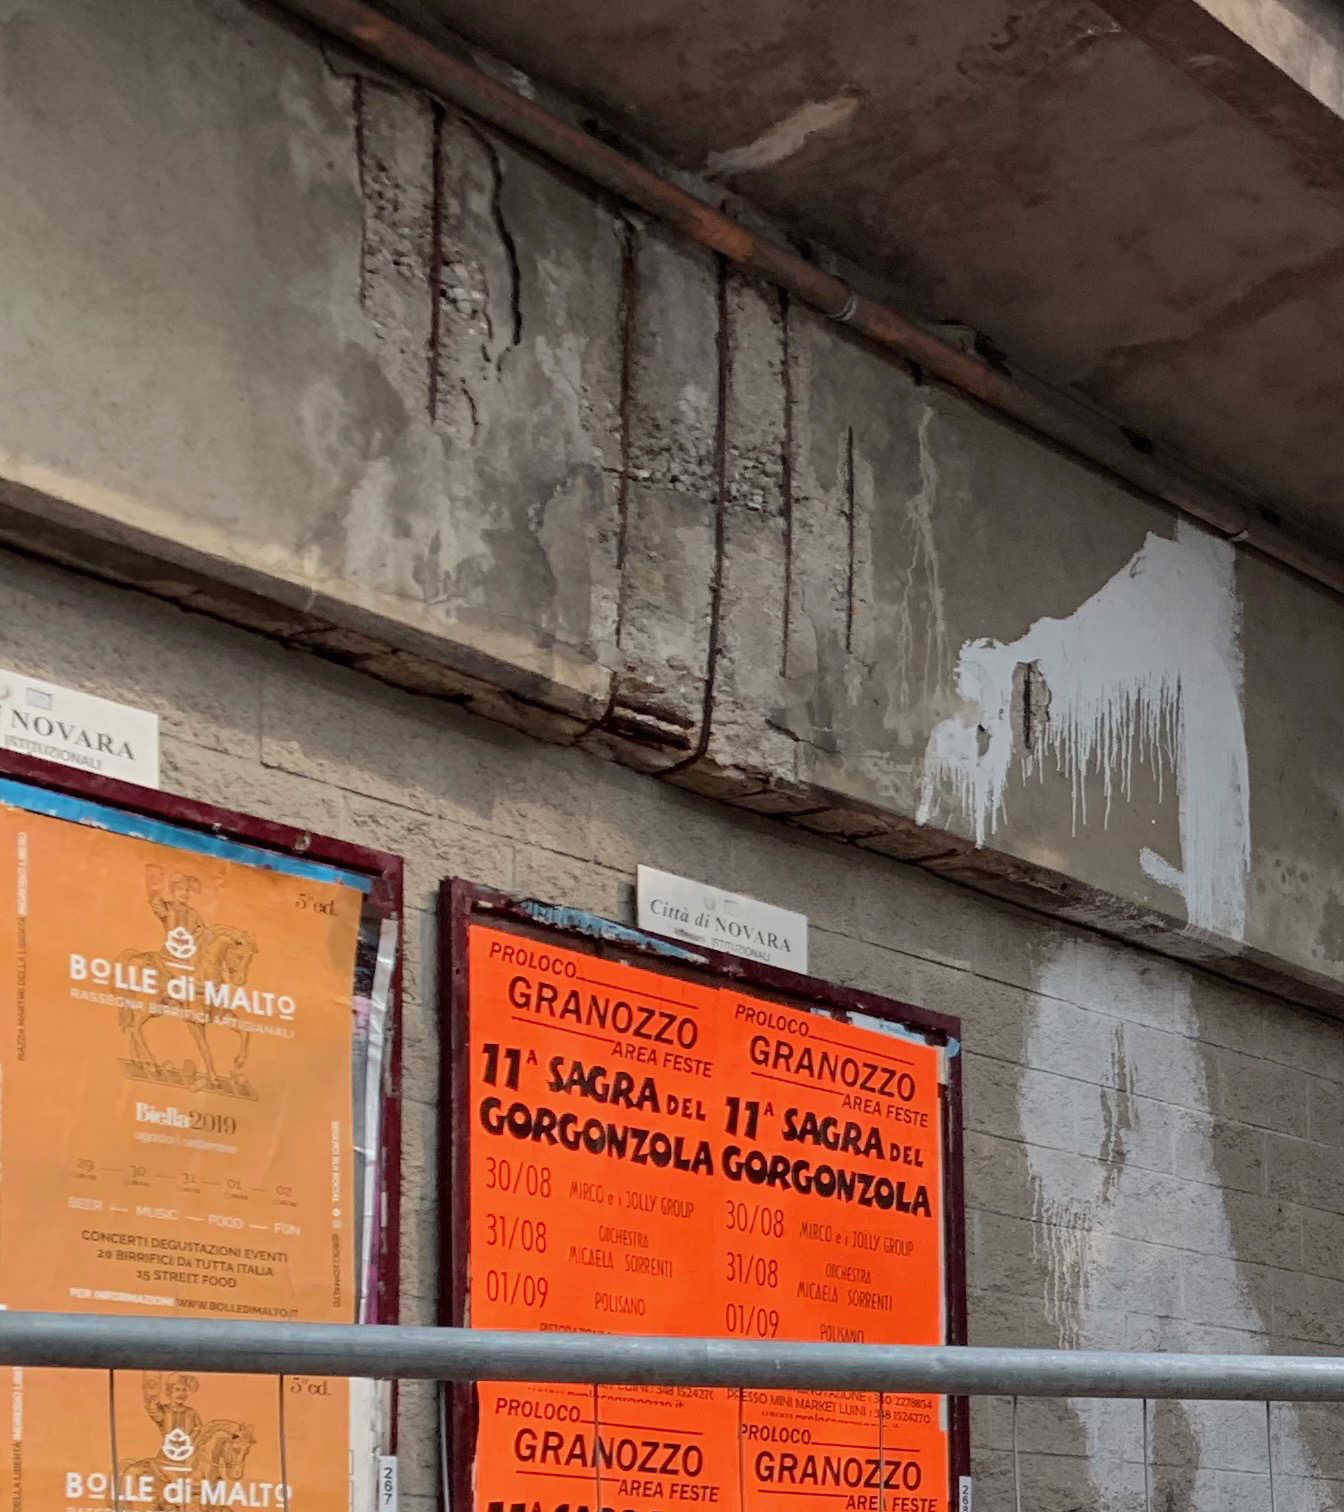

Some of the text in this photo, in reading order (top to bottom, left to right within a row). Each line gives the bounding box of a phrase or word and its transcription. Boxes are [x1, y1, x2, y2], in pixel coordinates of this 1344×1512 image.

[11, 708, 136, 761] NOVARA
[650, 898, 690, 924] Città
[695, 914, 710, 930] di
[714, 917, 792, 953] NOVARA
[489, 941, 577, 979] PROLOCO
[69, 953, 296, 1021] BOLLE di MALTO
[70, 988, 296, 1039] RASSEGNA BIRRIFICI ARTIGIANALI
[508, 975, 698, 1050] GRANOZZO
[735, 1004, 809, 1037] PROLOCO
[611, 1041, 714, 1078] AREA FESTE
[750, 1035, 915, 1102] GRANOZZO
[546, 1055, 661, 1113] SAGRA
[667, 1094, 707, 1122] DEL
[842, 1093, 928, 1128] AREA FESTE
[480, 1096, 714, 1176] GORGONZOLA
[782, 1107, 885, 1160] SAGRA
[889, 1143, 924, 1168] DEL
[485, 1157, 552, 1199] 30/08
[569, 1181, 604, 1204] MIRCO
[625, 1190, 657, 1213] JOLLY
[660, 1197, 695, 1219] GROUP
[722, 1145, 932, 1218] GORGONZOLA
[136, 1205, 178, 1221] MUSIC
[208, 1214, 245, 1230] FOOD
[486, 1213, 650, 1254] 31/08 ORCHESTRA
[726, 1200, 784, 1238] 30/08
[800, 1222, 832, 1243] MIRCO
[852, 1231, 881, 1251] JOLLY
[883, 1236, 914, 1256] GROUP
[81, 1229, 288, 1264] CONCERTI DEGUSTAZIONI EVENTI
[115, 1250, 174, 1267] BIRRIFICI
[196, 1259, 234, 1274] TUTTA
[237, 1263, 274, 1278] ITALIA
[568, 1246, 674, 1279] MICAELA SORRENTI
[153, 1270, 200, 1285] STREET
[202, 1274, 237, 1289] FOOD
[726, 1251, 872, 1289] 31/08 ORCHESTRA
[486, 1269, 646, 1317] 01/09 POLISANO
[797, 1281, 893, 1312] MICAELA SORRENTI
[725, 1303, 780, 1339] 01/09
[495, 1397, 581, 1423] PROLOCO
[796, 1398, 837, 1412] MARKET
[839, 1403, 866, 1416] LUINI
[514, 1427, 704, 1478] GRANOZZO
[741, 1424, 811, 1445] PROLOCO
[383, 1467, 394, 1505] 267
[755, 1451, 921, 1491] GRANOZZO
[163, 1478, 191, 1504] di
[200, 1479, 292, 1509] MALTO
[618, 1479, 720, 1503] AREA FESTE
